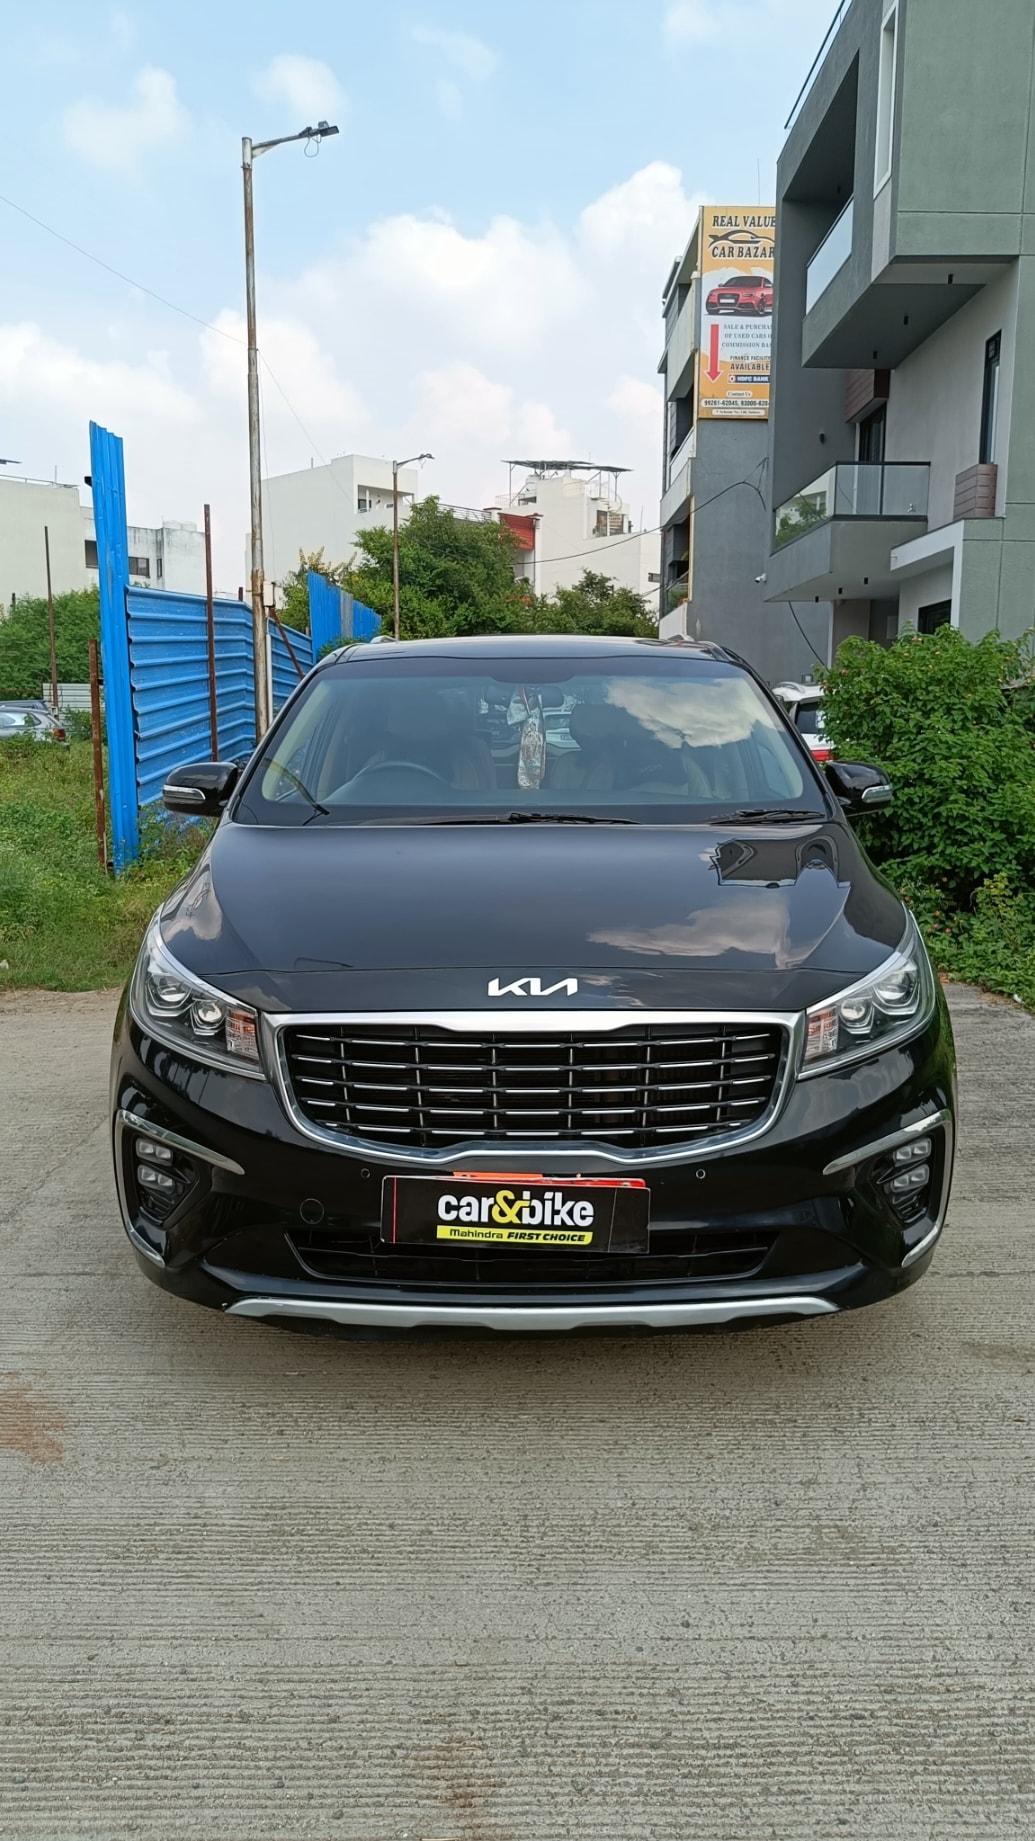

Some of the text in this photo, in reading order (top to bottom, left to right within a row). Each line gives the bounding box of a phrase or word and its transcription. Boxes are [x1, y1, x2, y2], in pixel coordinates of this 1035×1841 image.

[712, 215, 776, 227] REAL VALUE
[711, 246, 734, 258] CAR
[730, 363, 770, 371] AVAILABLE
[488, 978, 578, 997] KIA
[437, 1189, 594, 1227] car&bike
[449, 1228, 586, 1242] Mahindra FIRST CHOICE
